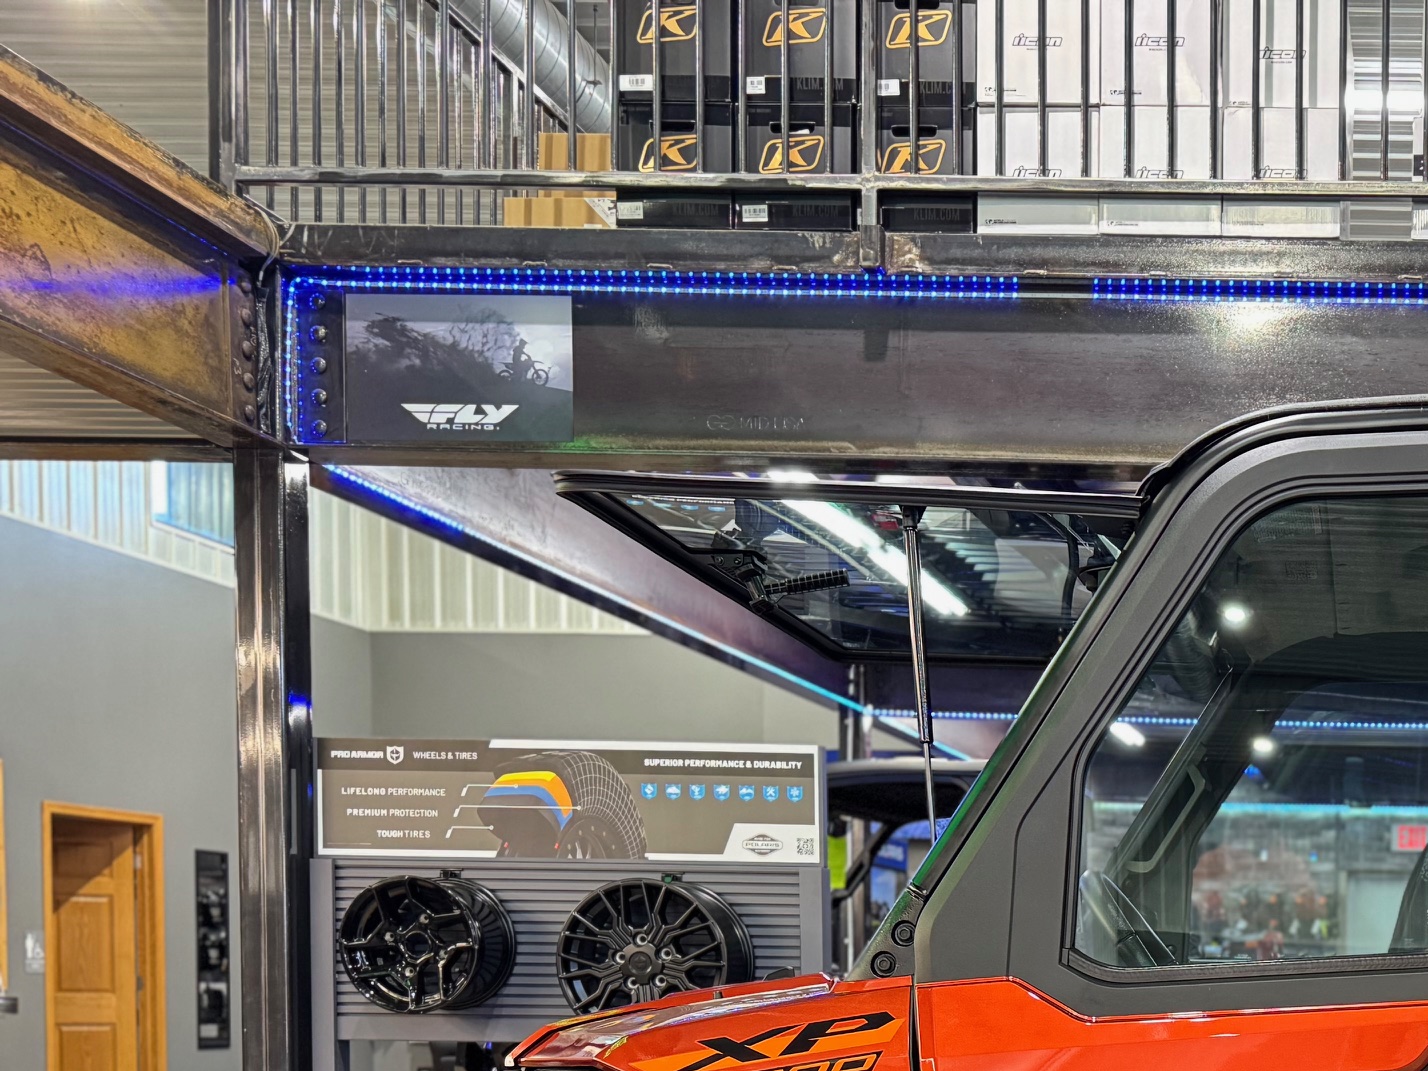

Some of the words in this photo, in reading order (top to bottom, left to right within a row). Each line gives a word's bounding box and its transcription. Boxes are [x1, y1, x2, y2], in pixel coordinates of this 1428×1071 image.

[401, 403, 520, 424] FLY
[413, 751, 447, 760] WHEELS
[447, 751, 454, 760] &
[455, 751, 478, 760] TIRES
[643, 758, 684, 767] SUPERIOR
[684, 759, 745, 769] PERFORMANCE
[745, 760, 752, 768] &
[753, 761, 802, 770] DURABILITY
[341, 787, 386, 796] LIFELONG
[387, 787, 446, 797] PERFORMANCE
[346, 808, 388, 817] PREMIUM
[389, 809, 439, 818] PROTECTION
[376, 830, 403, 839] TOUGH
[404, 830, 431, 839] TIRES
